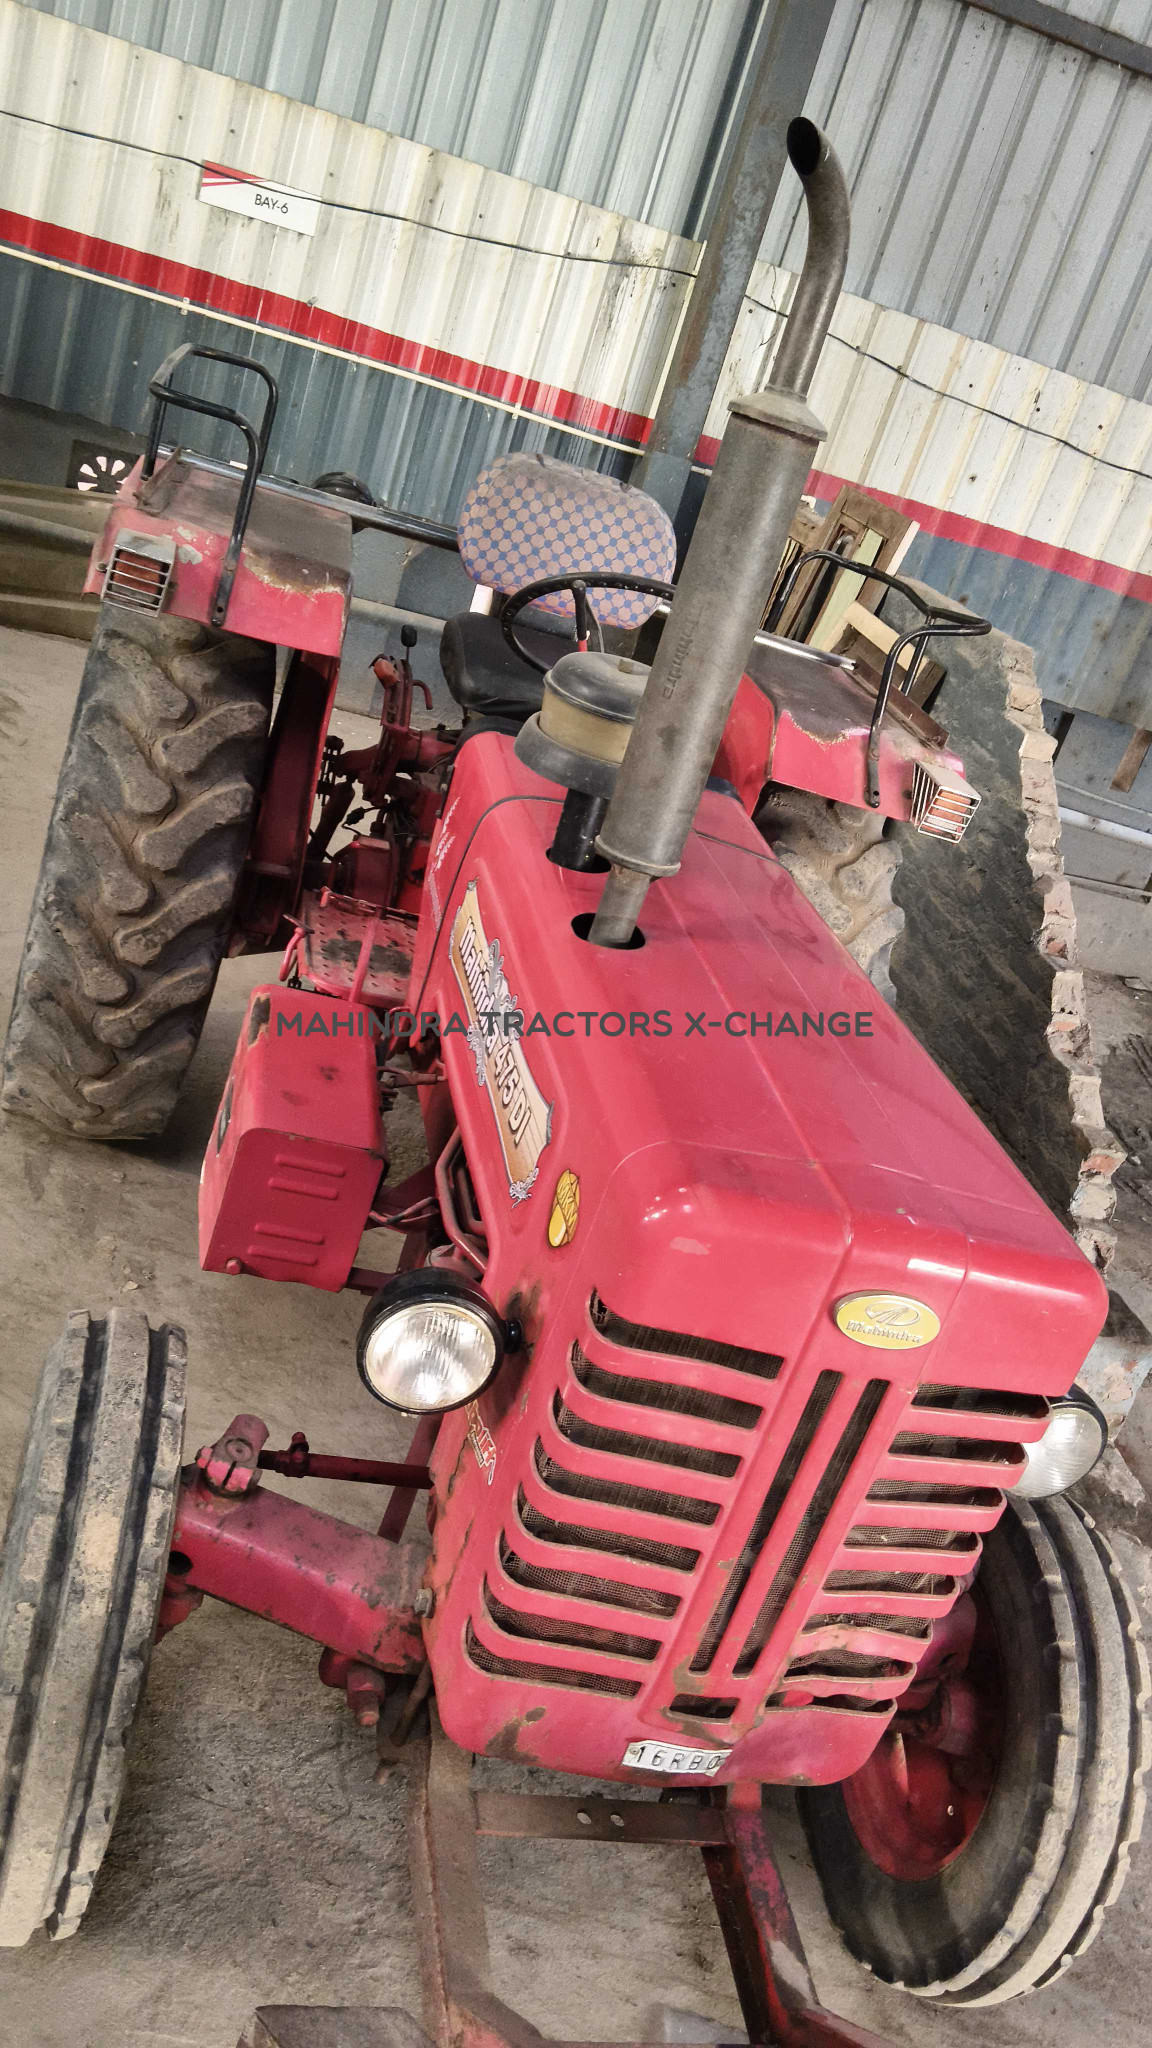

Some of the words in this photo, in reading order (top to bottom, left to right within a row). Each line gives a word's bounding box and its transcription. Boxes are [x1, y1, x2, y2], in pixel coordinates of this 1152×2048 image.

[254, 193, 289, 214] BAY-6
[495, 1042, 520, 1109] 475
[508, 1088, 531, 1147] DI
